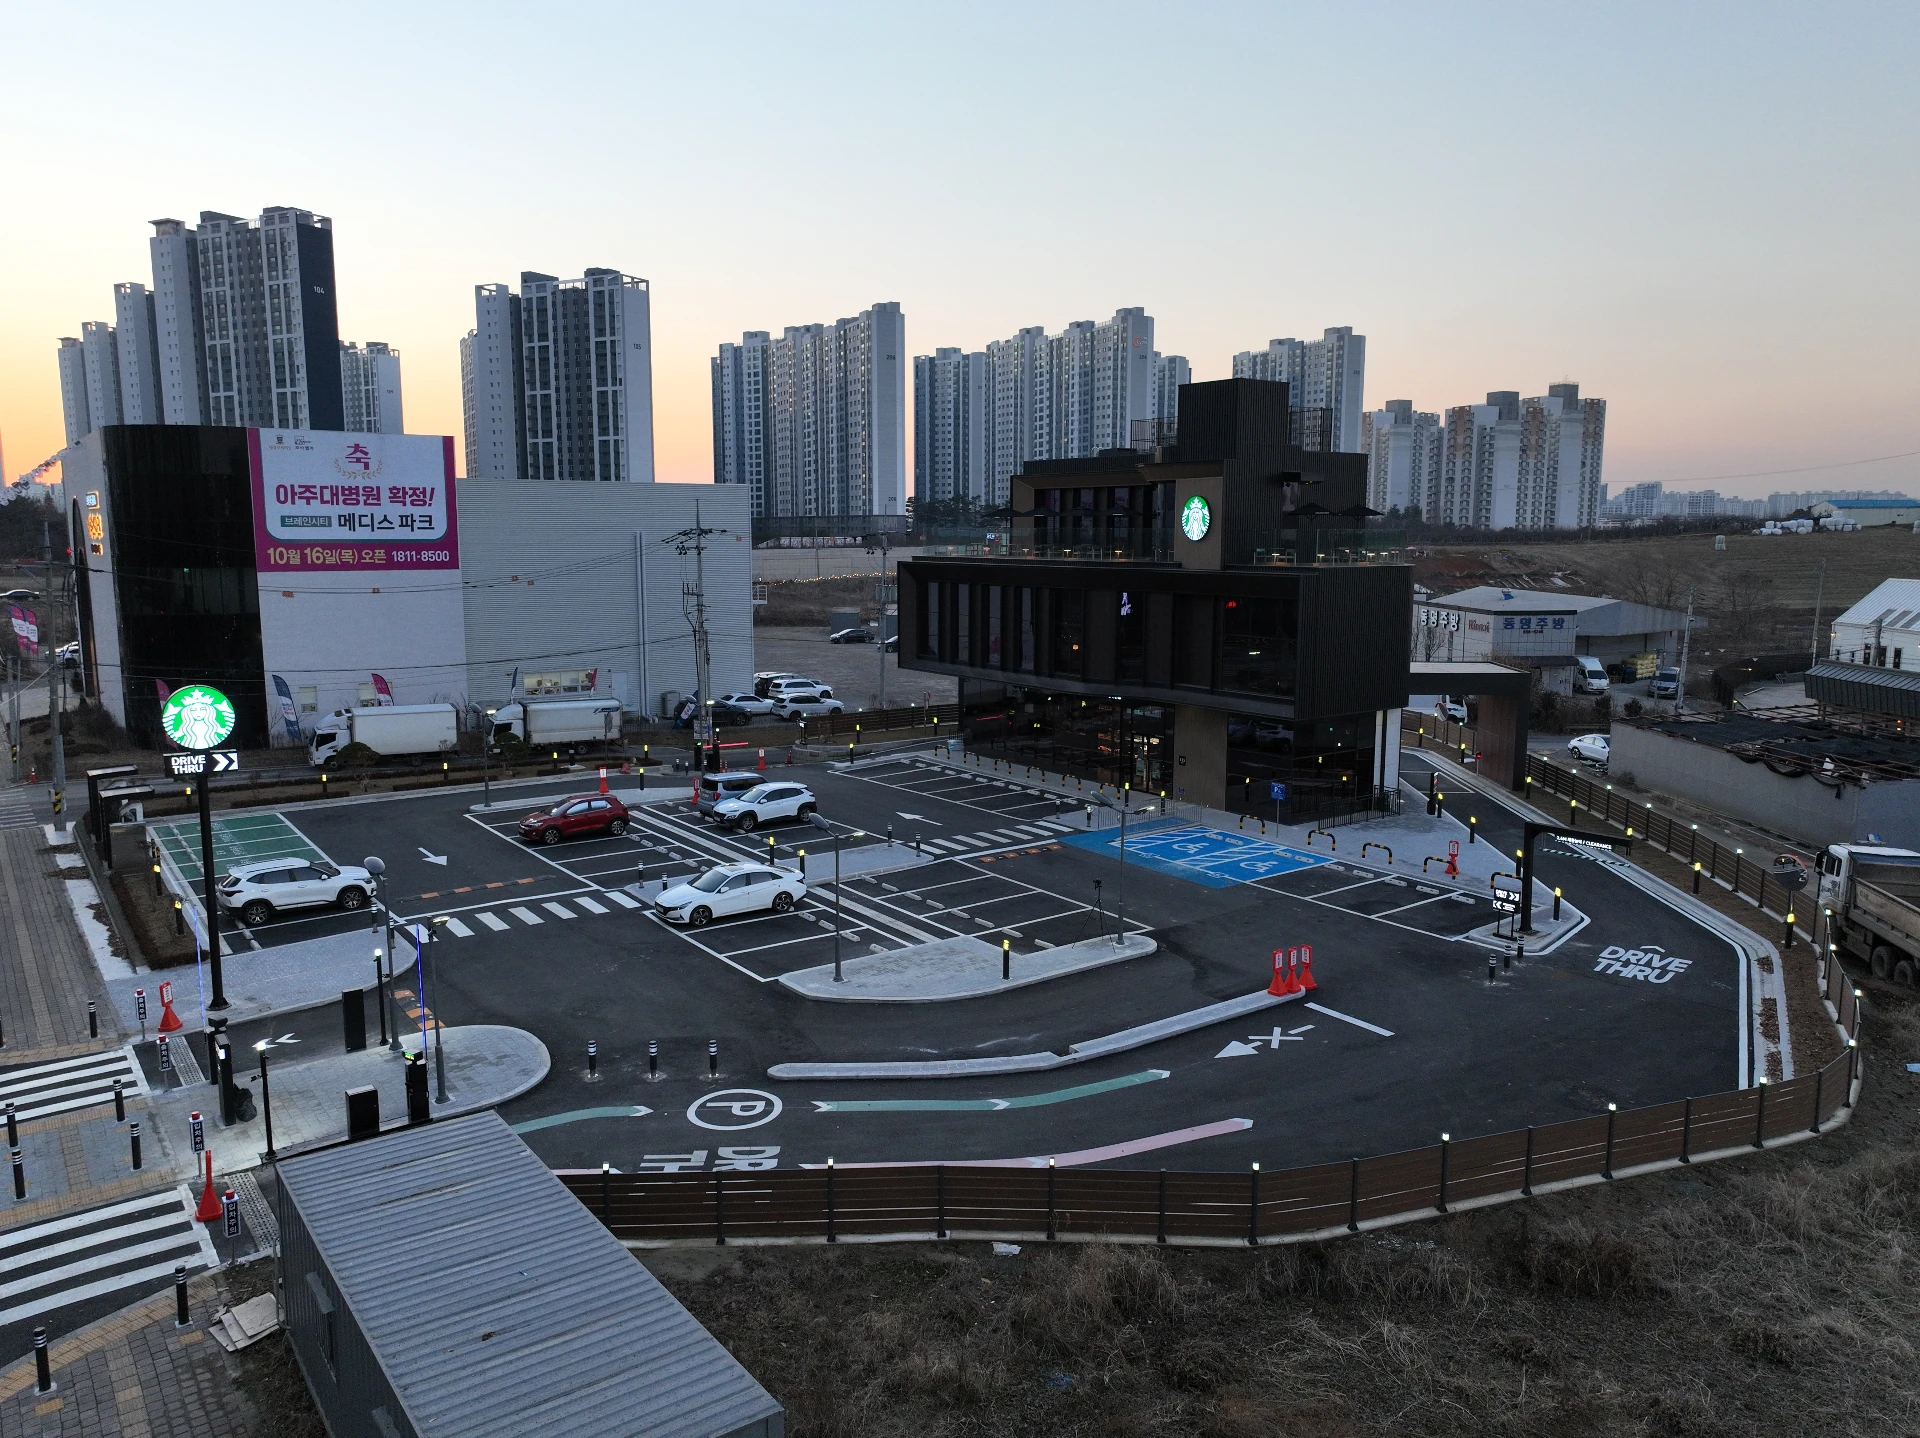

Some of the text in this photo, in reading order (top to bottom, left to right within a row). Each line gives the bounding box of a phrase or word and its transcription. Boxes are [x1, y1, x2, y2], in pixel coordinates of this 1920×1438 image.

[313, 285, 325, 294] 104
[345, 443, 371, 471] 축
[275, 484, 435, 508] 아주대병원 확정!
[284, 513, 435, 533] 브레인시티 메디스파크
[267, 546, 450, 565] 10월 16일(목) 오픈 1811-8500
[1420, 608, 1460, 631] 동명주방
[1503, 617, 1566, 630] 동명주방
[171, 754, 206, 767] DRIVE
[172, 764, 204, 775] THRU
[1585, 840, 1612, 849] CLEARANCE
[1599, 945, 1693, 973] DRIVE
[1593, 958, 1676, 984] THRU
[706, 1100, 766, 1116] P
[194, 1122, 203, 1150] 입차주의
[228, 1202, 237, 1234] 입차주의
